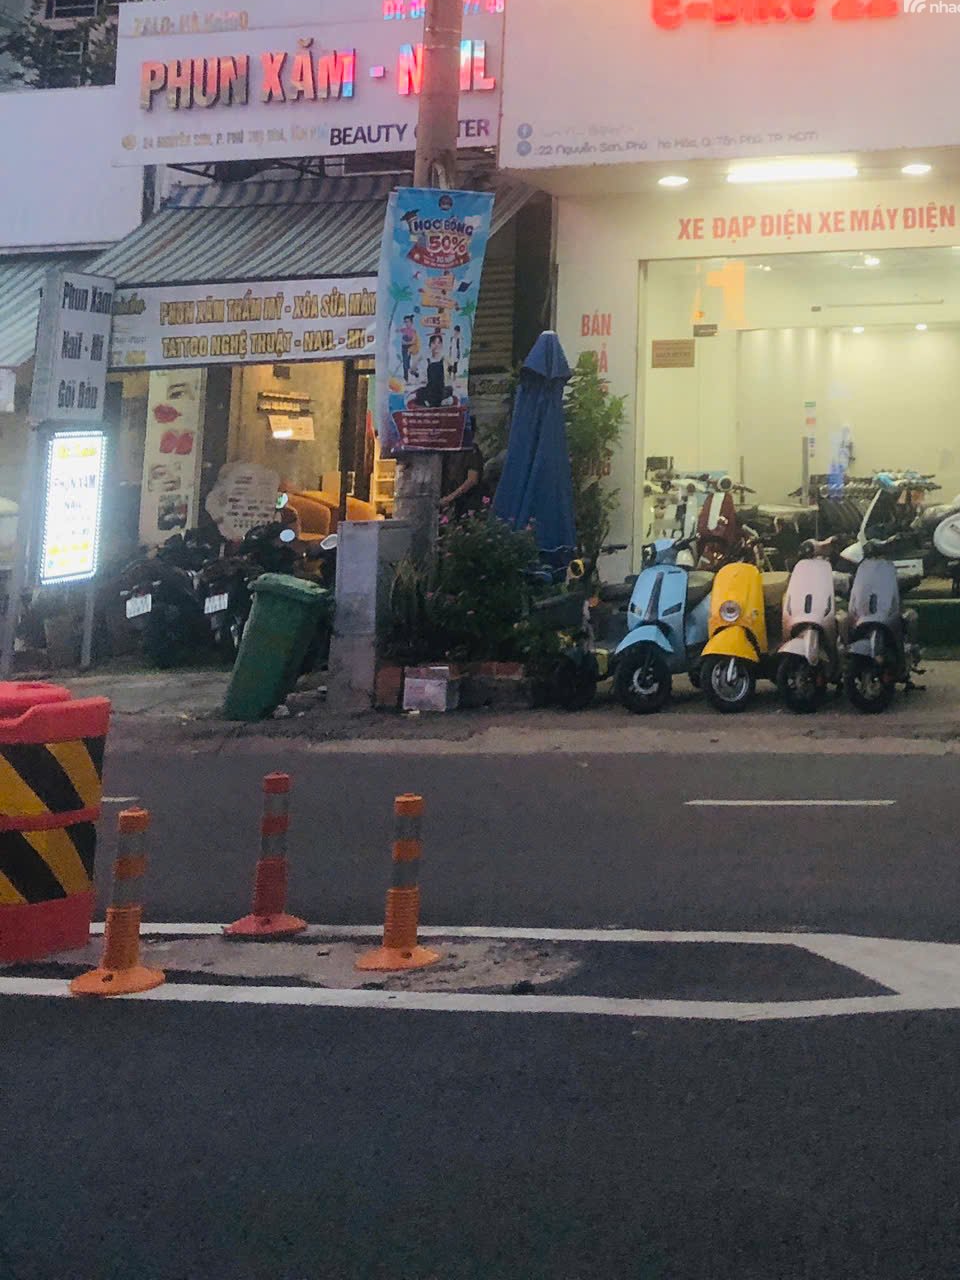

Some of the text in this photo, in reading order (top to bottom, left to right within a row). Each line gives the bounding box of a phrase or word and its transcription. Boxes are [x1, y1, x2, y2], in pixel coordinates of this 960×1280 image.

[141, 56, 250, 111] PHUN
[259, 37, 356, 105] XĂM
[397, 39, 497, 96] NIL
[330, 122, 407, 147] BEAUTY
[678, 201, 956, 243] XE ĐẠP ĐIỆN XE MÁY ĐIỆN
[427, 235, 467, 254] 50%
[581, 310, 612, 337] BÁN
[162, 336, 209, 359] TATTOO
